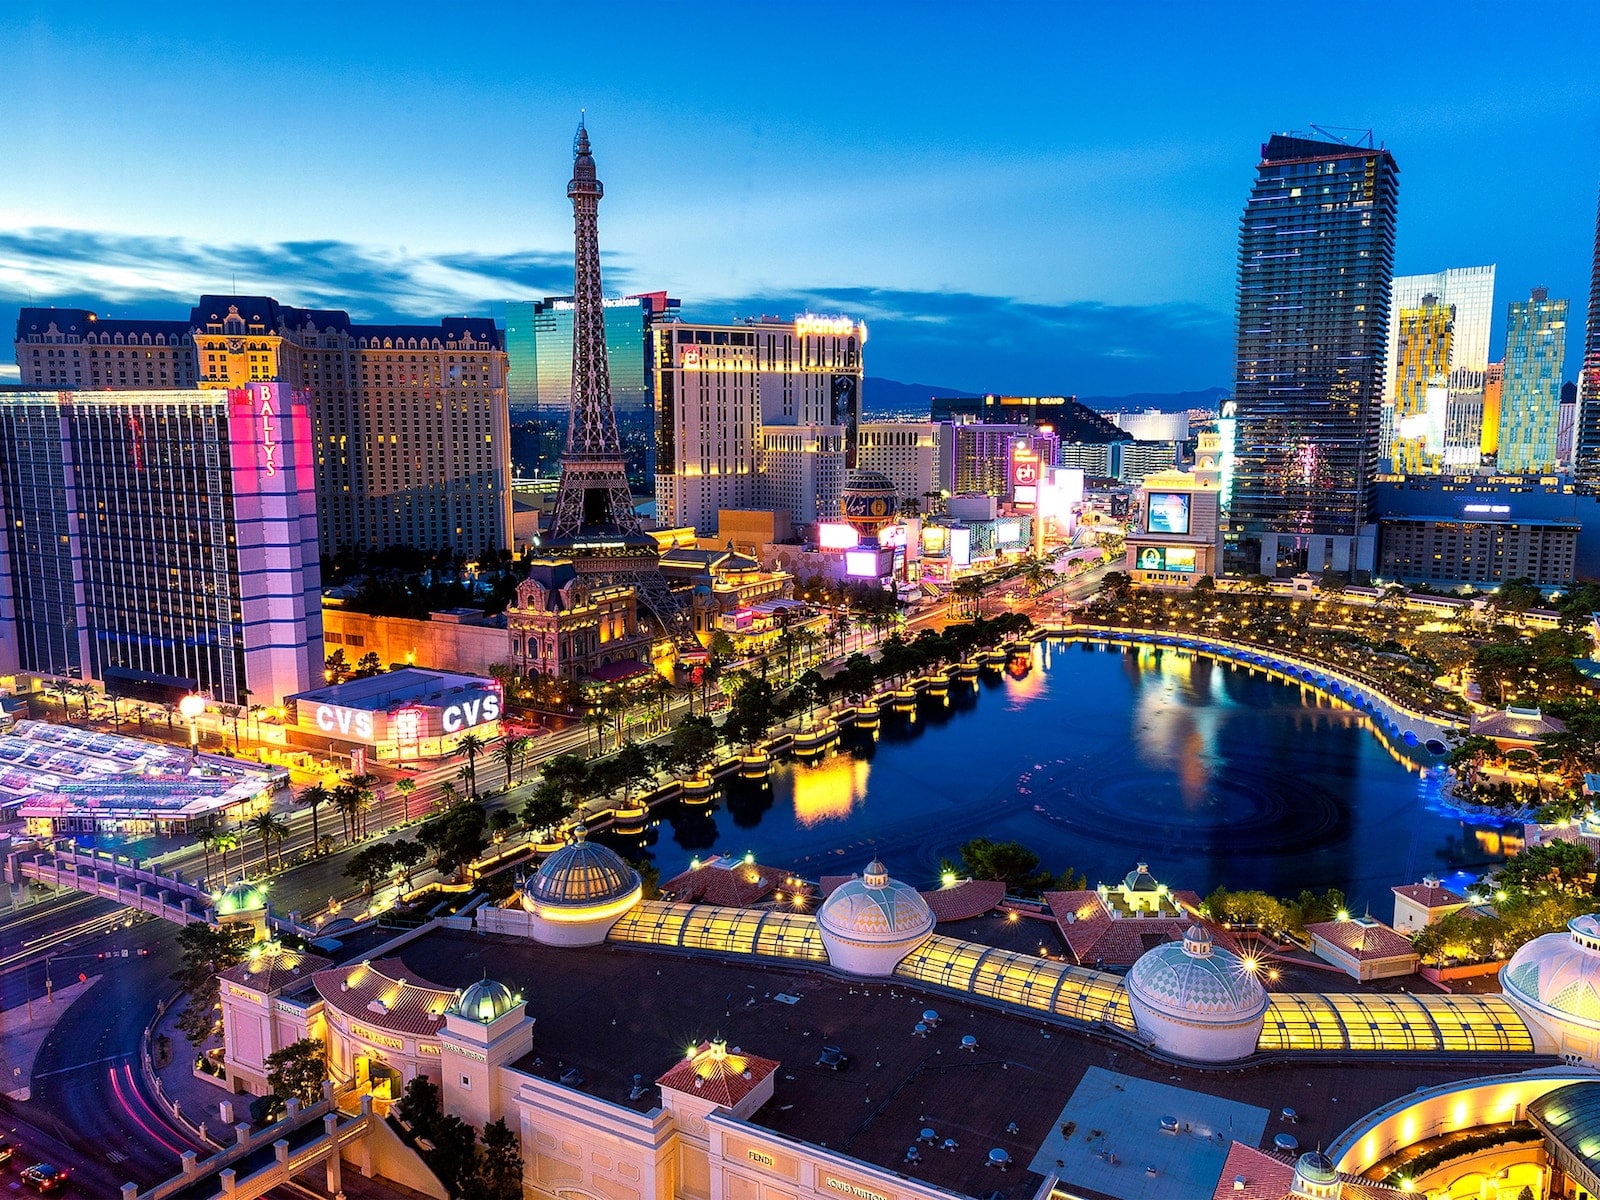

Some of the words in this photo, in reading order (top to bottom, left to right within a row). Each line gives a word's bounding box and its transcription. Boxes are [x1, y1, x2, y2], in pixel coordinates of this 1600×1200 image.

[796, 314, 853, 337] planet
[1040, 397, 1065, 405] GRAND
[316, 705, 373, 738] CVS
[442, 694, 500, 733] CVS
[748, 1151, 773, 1166] FENDI
[826, 1177, 850, 1193] LOUIS
